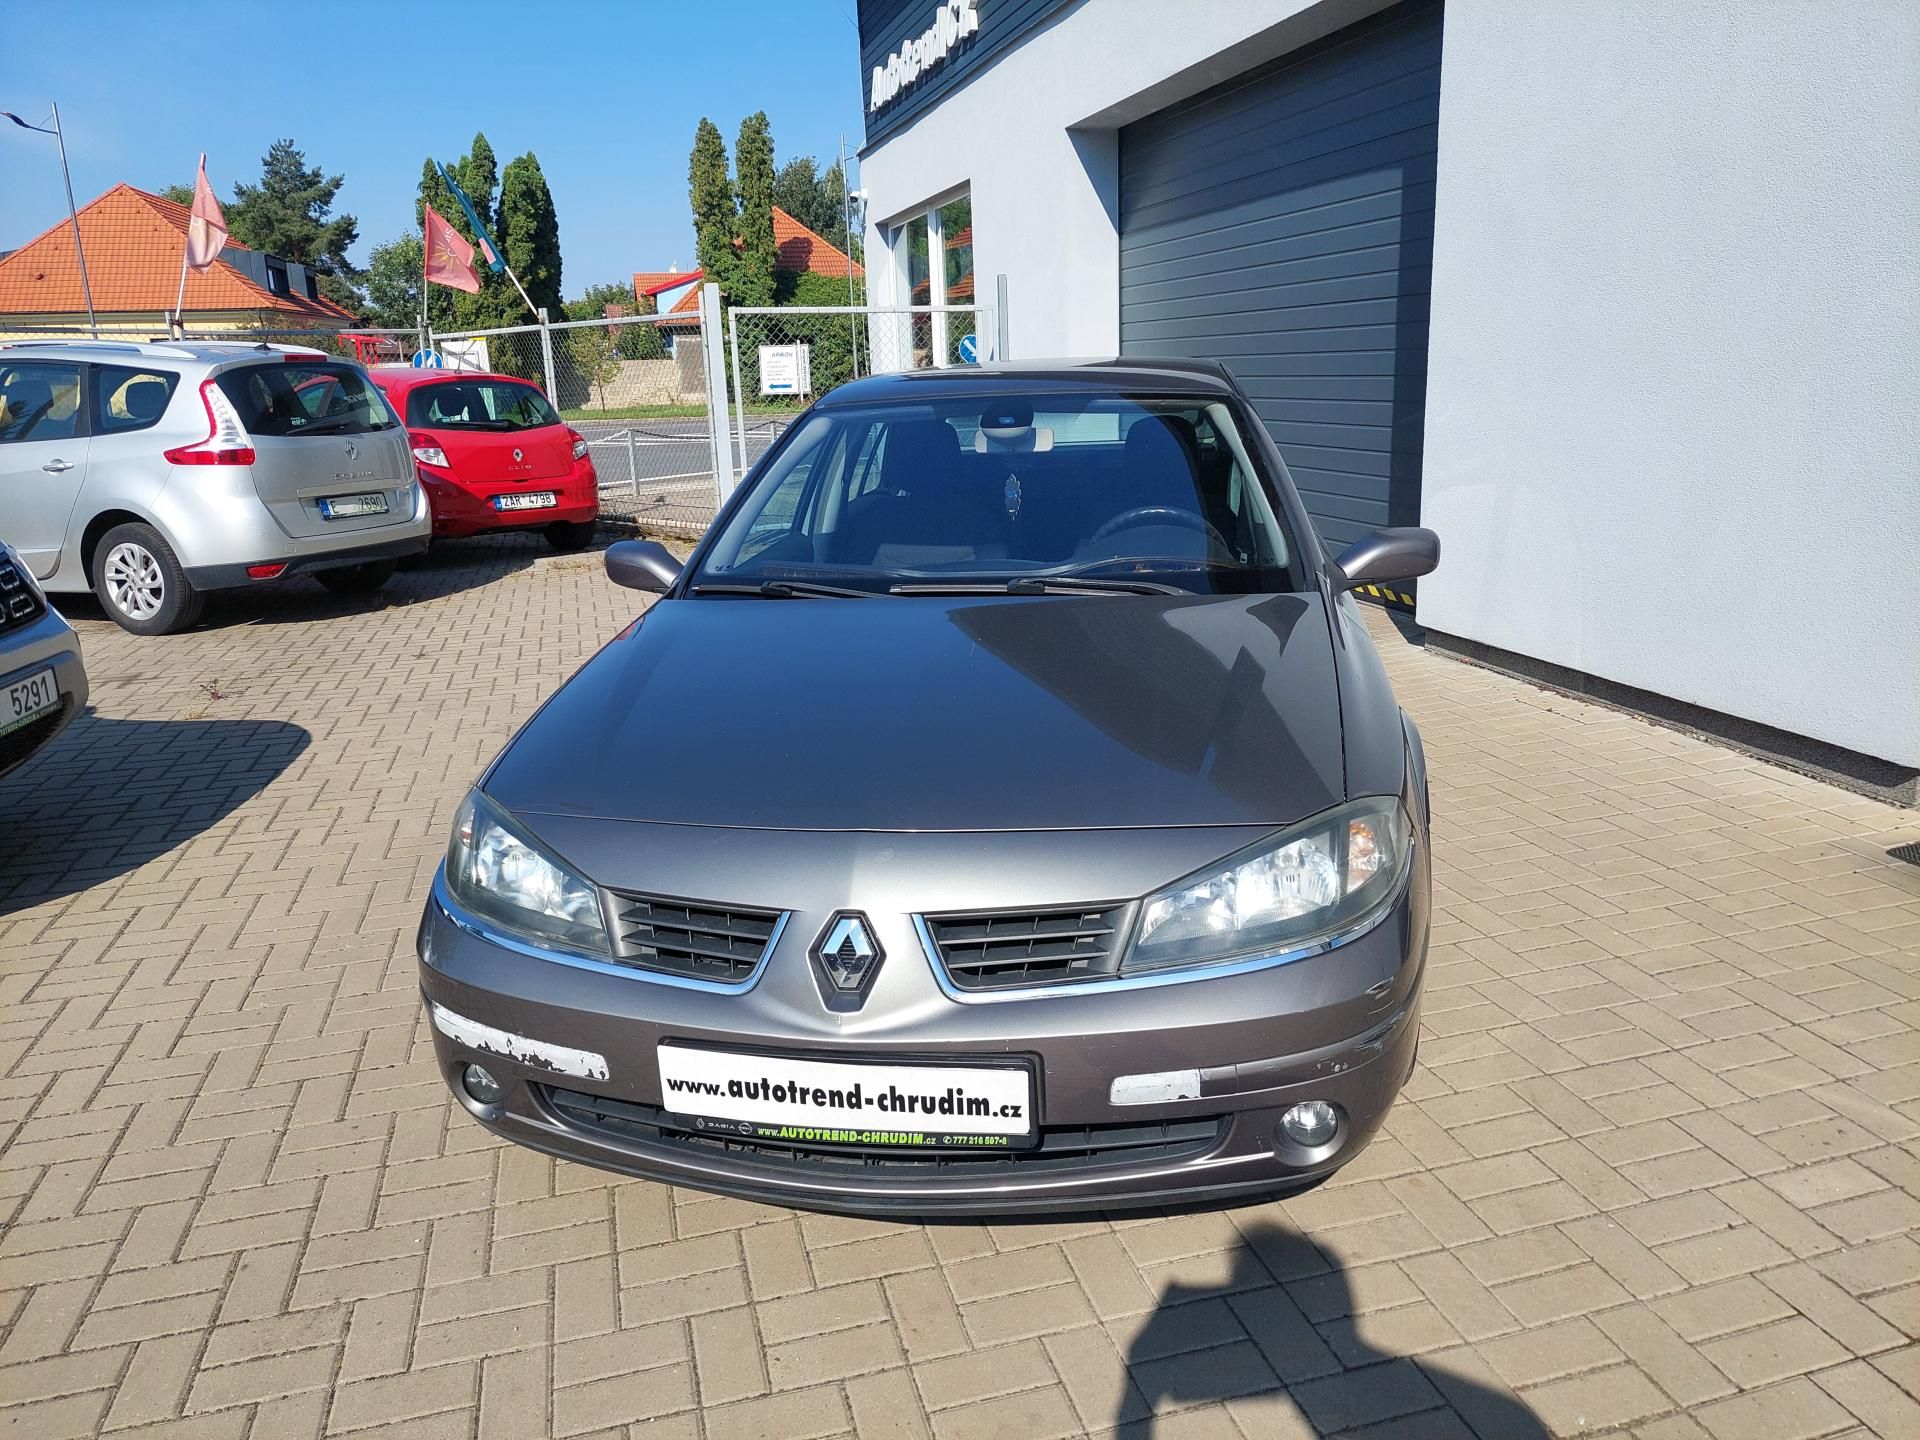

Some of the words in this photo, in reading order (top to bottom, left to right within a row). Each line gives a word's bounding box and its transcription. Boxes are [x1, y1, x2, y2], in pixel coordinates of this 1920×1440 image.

[528, 493, 552, 504] 4798
[10, 676, 50, 716] 5291
[666, 1077, 1022, 1118] www.autotrend-chrudim.cz
[757, 1126, 936, 1145] www.AUTOTREND-CHRUDIM.cz
[952, 1136, 968, 1144] 777
